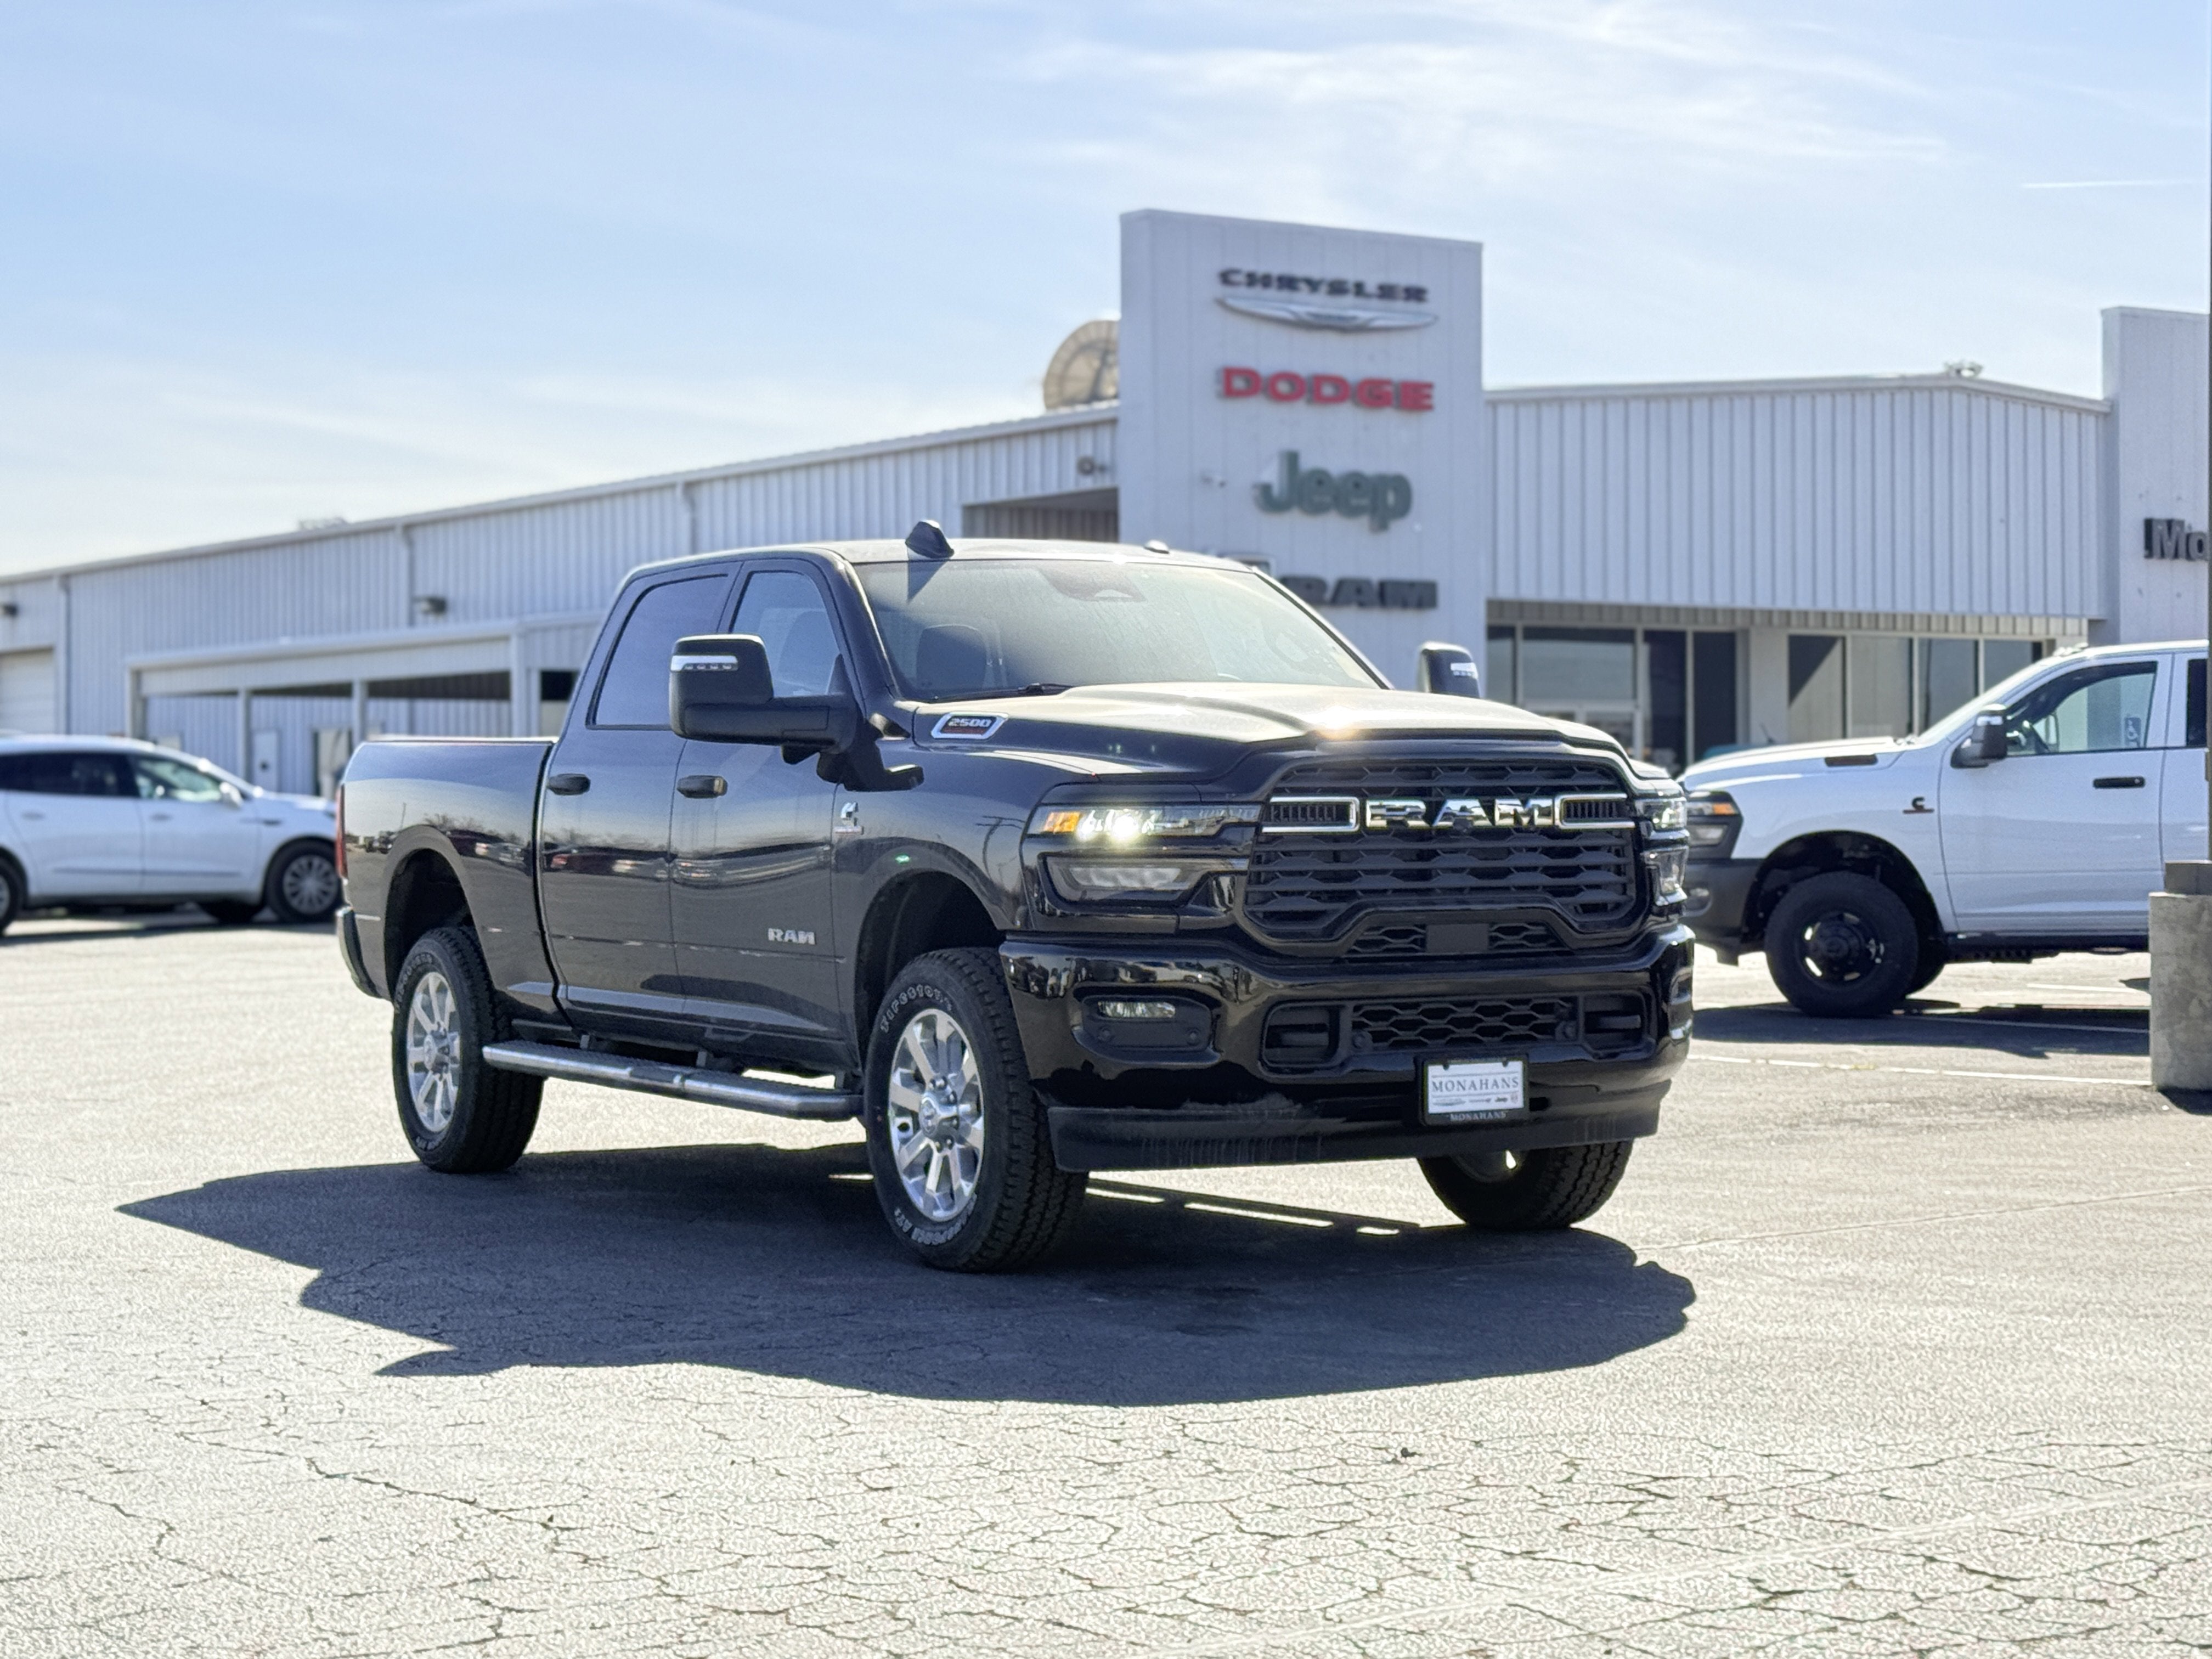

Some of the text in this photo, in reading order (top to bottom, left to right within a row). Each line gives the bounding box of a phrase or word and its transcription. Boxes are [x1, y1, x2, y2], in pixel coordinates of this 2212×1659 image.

[1219, 268, 1428, 303] CHRYSLER
[1220, 366, 1435, 411] DODGE
[1252, 449, 1412, 533] Jeep
[948, 718, 992, 727] 2500
[1365, 798, 1554, 828] RAM
[768, 928, 816, 945] RAM
[1431, 1076, 1519, 1092] MONAHANS
[1449, 1110, 1506, 1121] MONAHANS
